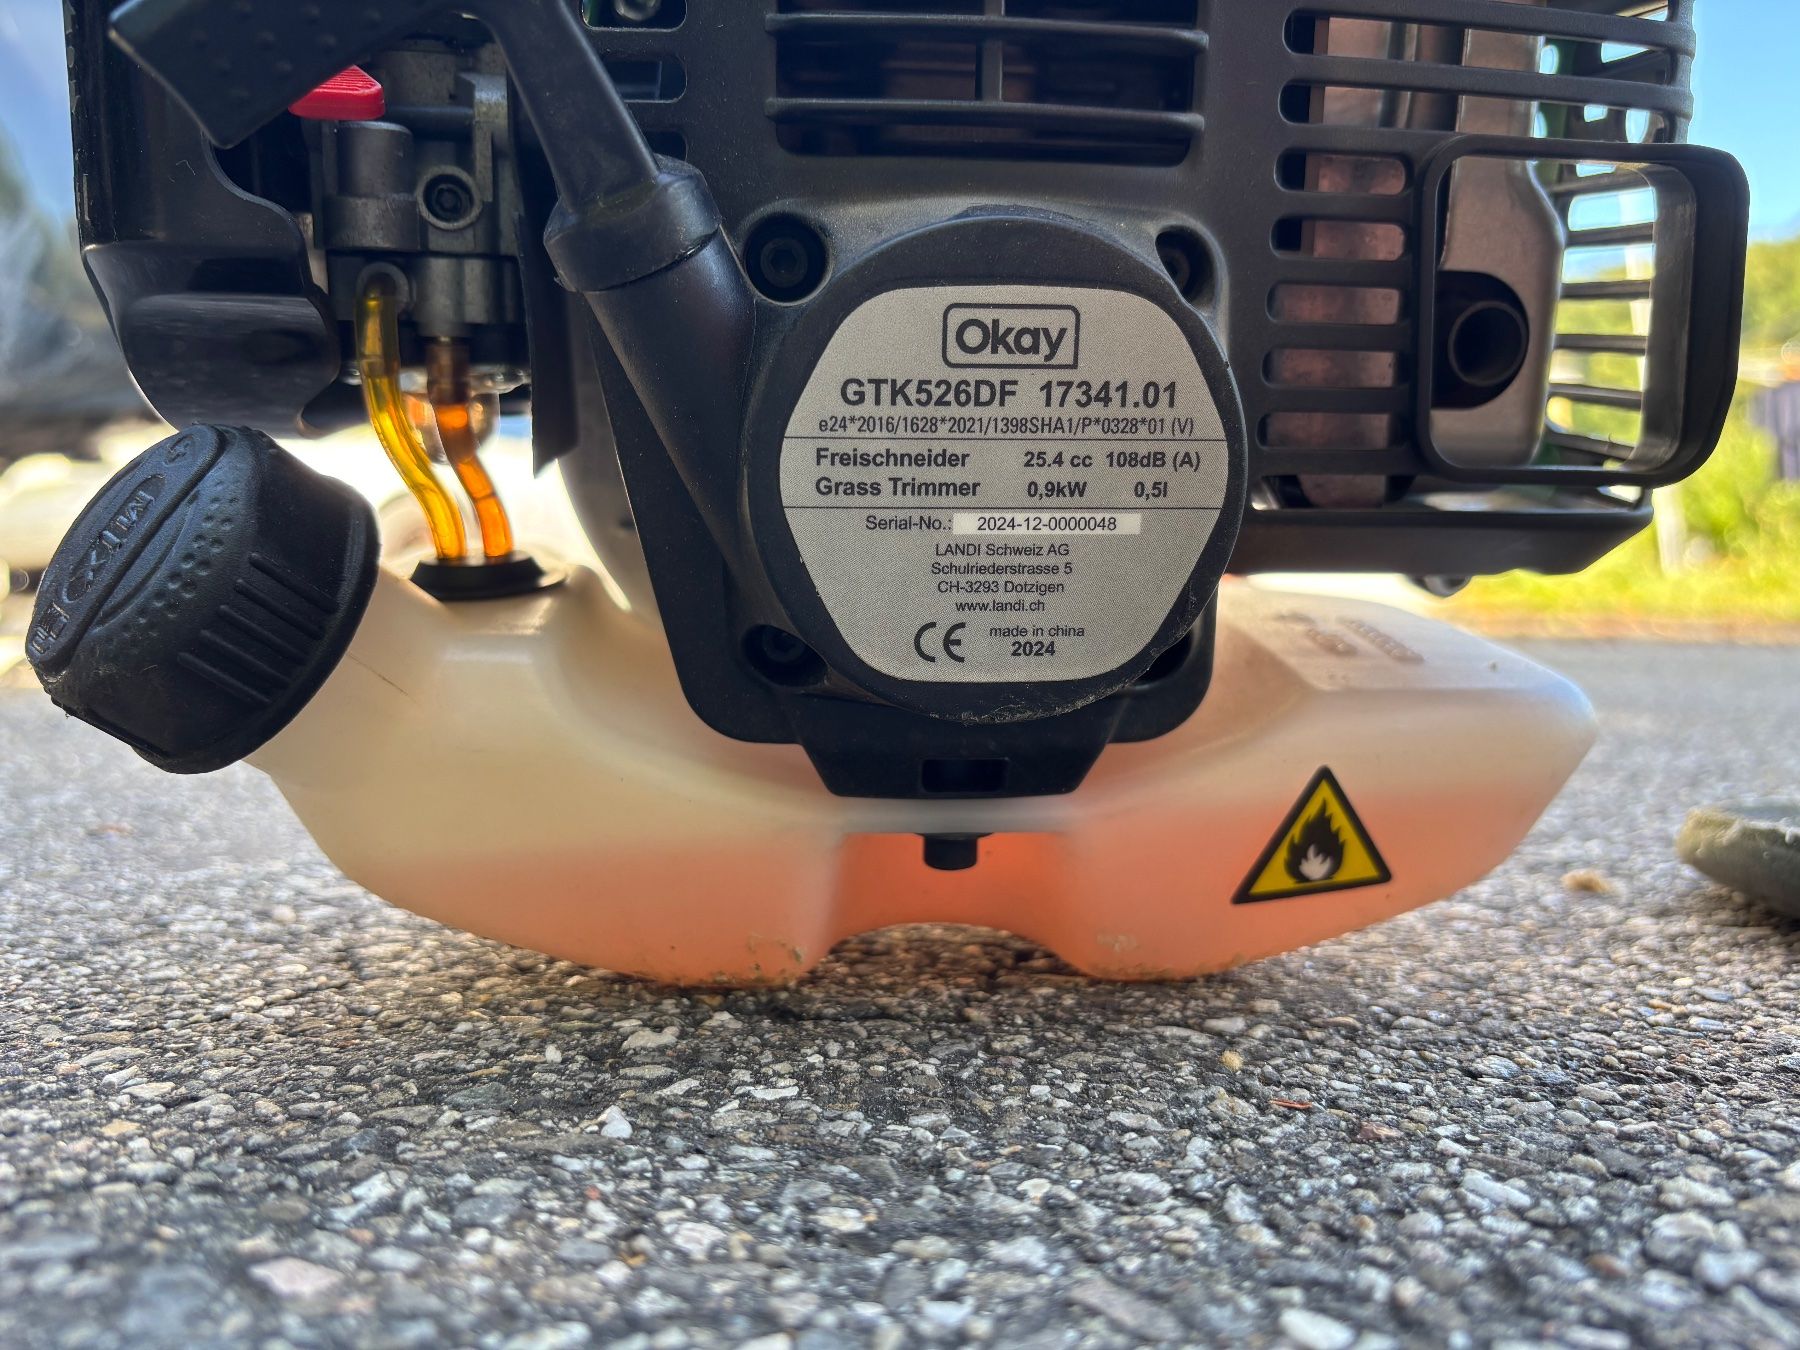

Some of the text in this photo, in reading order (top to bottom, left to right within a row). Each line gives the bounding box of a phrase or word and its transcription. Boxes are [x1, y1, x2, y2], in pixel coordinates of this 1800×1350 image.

[955, 318, 1068, 363] Okay
[840, 377, 1176, 409] GTK526DF 17341.01
[1171, 417, 1194, 437] (V)
[816, 447, 970, 468] Freischneider
[1023, 450, 1201, 473] 25.4 cc 108dB (A)
[815, 476, 981, 497] Grass Trimmer
[1027, 480, 1088, 500] 0,9kW
[865, 514, 1117, 532] Serial-No.: 2024-12-0000048
[935, 542, 1070, 557] LANDI Schweiz AG
[931, 561, 1073, 576] Schulriederstrasse 5
[937, 580, 1065, 597] CH-3293 Dotzigen
[955, 599, 1045, 612] www.landi.ch
[989, 624, 1085, 638] made in china
[913, 621, 967, 664] CE
[1010, 640, 1056, 657] 2024
